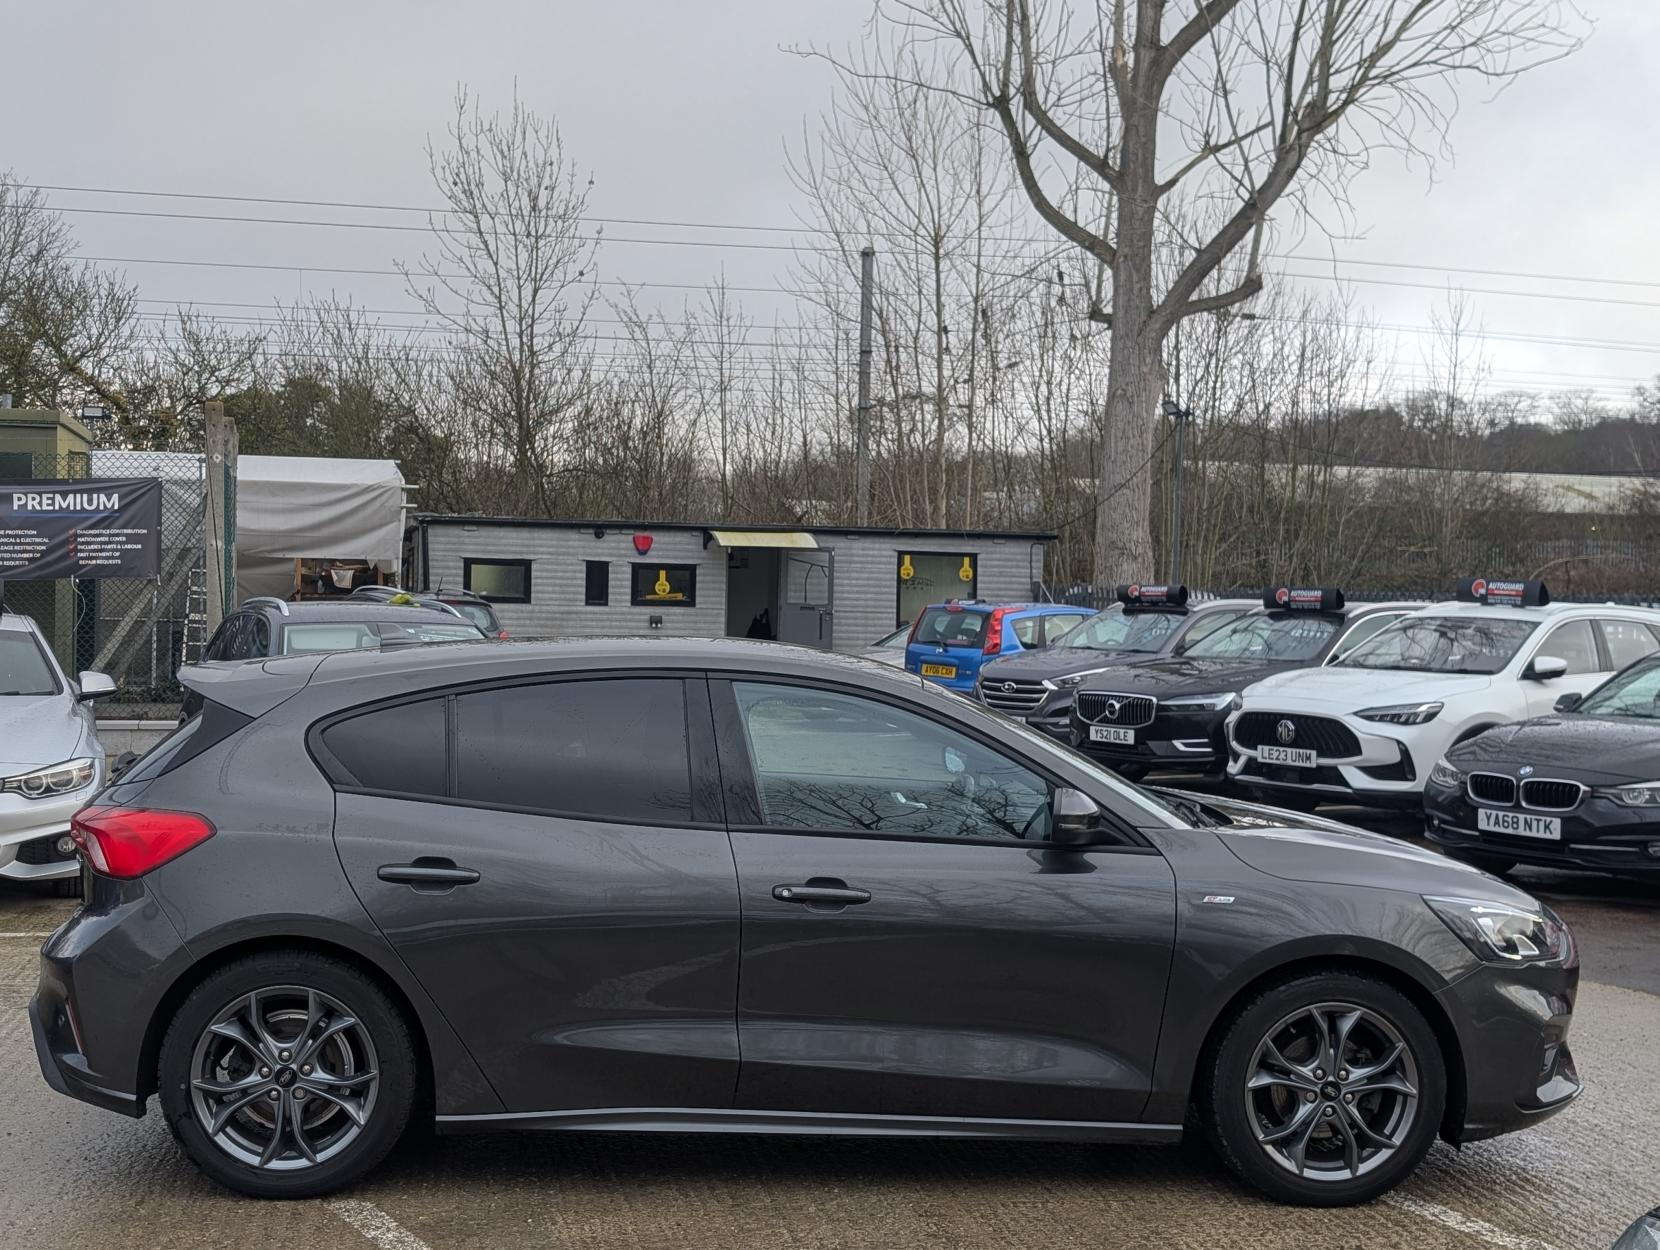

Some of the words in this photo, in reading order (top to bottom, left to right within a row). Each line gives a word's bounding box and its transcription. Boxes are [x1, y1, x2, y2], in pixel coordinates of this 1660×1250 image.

[13, 493, 119, 510] PREMIUM
[1487, 582, 1525, 591] AUTOGUARD
[1094, 727, 1111, 741] YS21
[1112, 730, 1129, 742] OLE
[1261, 747, 1288, 762] LE23
[1290, 750, 1312, 764] UNM
[1484, 811, 1520, 830] YA68
[1523, 816, 1554, 835] NTK
